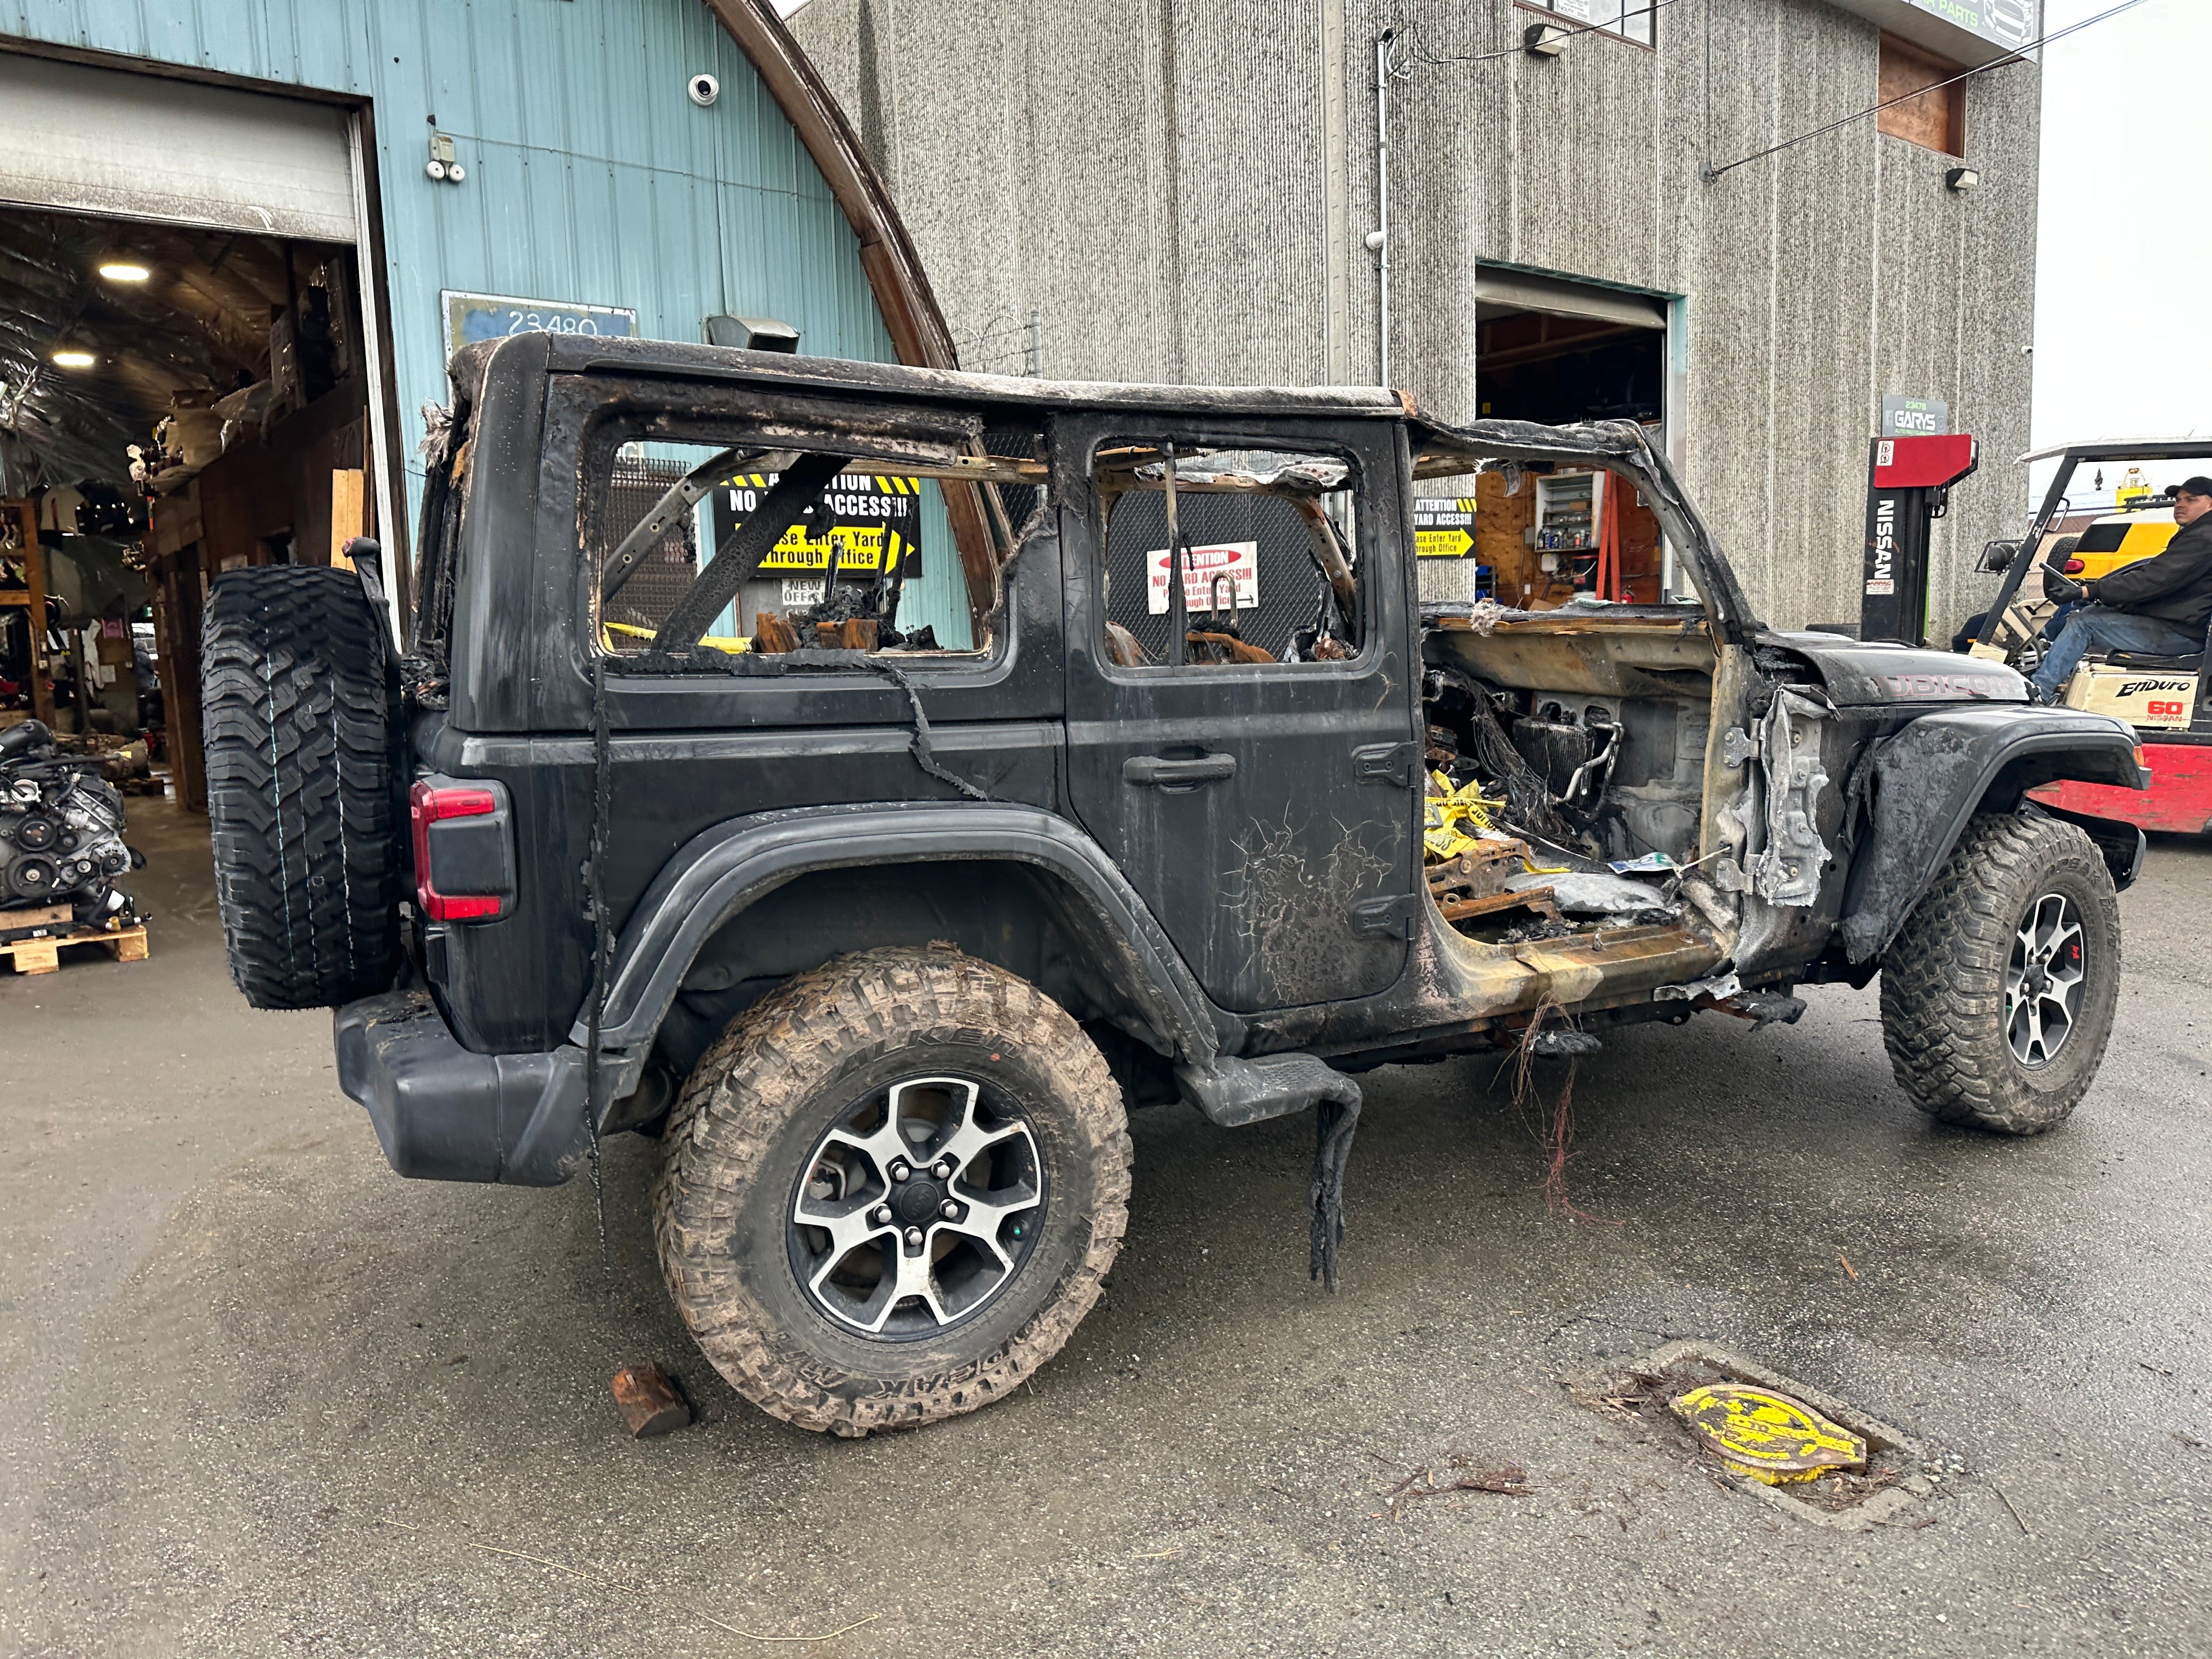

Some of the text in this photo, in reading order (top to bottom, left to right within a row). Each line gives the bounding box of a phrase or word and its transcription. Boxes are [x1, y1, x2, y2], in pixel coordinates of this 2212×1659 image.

[1939, 0, 1978, 27] PARTS
[509, 310, 597, 336] 23480
[1895, 410, 1936, 431] GARYS
[730, 490, 756, 512] NO
[1415, 498, 1457, 512] ATTENTION
[1414, 513, 1472, 525] YARD ACCESS!!!
[853, 531, 884, 547] Yard
[1429, 533, 1446, 543] Enter
[1448, 533, 1461, 543] Yard
[1874, 499, 1895, 579] NISSAN
[1438, 543, 1457, 552] Office
[764, 548, 823, 566] hrough
[789, 579, 821, 590] NEW
[1153, 575, 1166, 588] NO
[1192, 585, 1211, 596] Ente
[1219, 582, 1241, 594] Yad
[2147, 700, 2183, 715] 60
